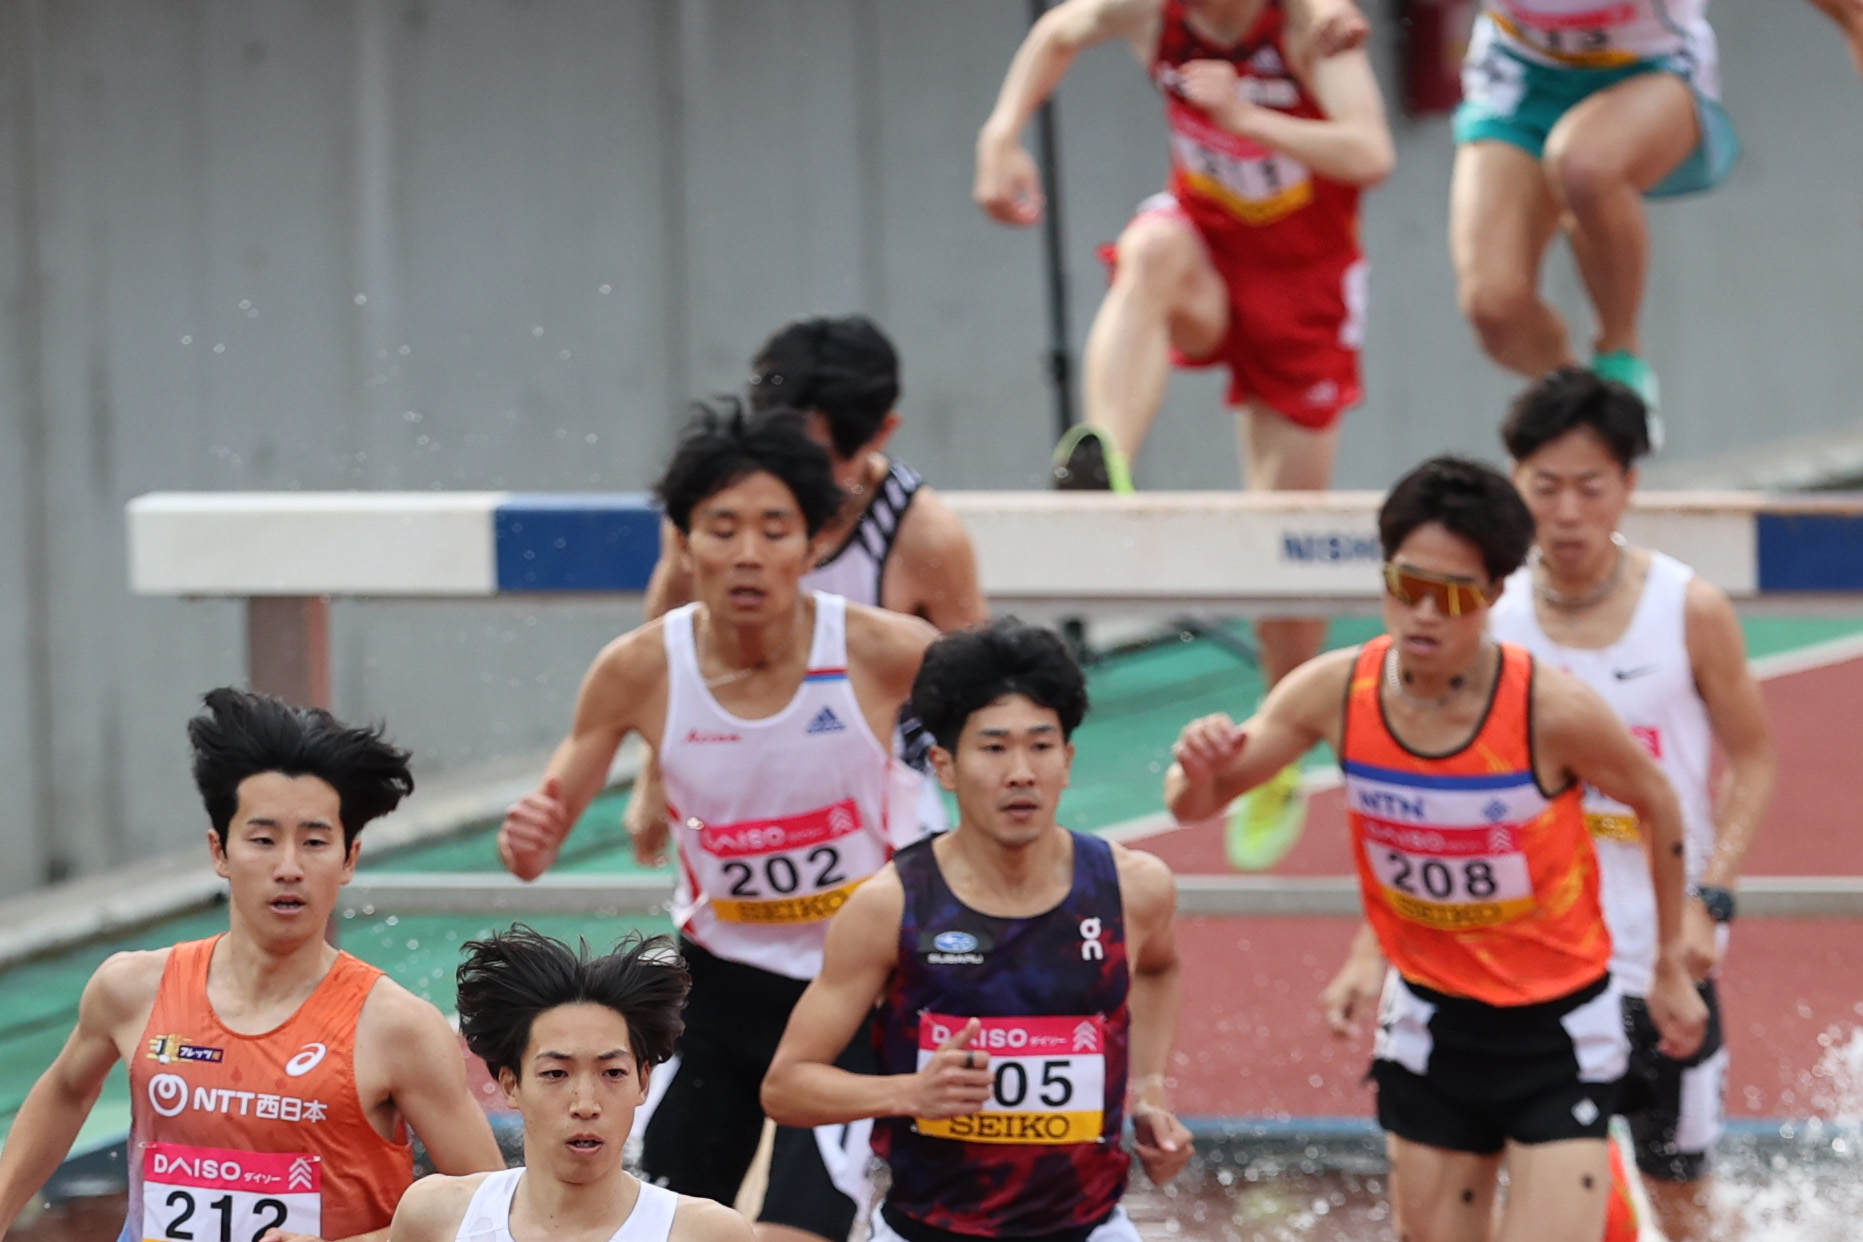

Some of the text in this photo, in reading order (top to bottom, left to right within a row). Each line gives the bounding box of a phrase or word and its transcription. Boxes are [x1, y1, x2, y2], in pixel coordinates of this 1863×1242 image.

[1283, 537, 1380, 560] NISH
[1360, 791, 1424, 819] NTN
[722, 846, 846, 897] 202
[1388, 851, 1496, 898] 208
[932, 1024, 1028, 1048] DISO
[993, 1060, 1073, 1107] 05
[193, 1087, 328, 1123] NTT西日本
[949, 1113, 1070, 1139] SEIKO
[154, 1153, 241, 1181] DAISO
